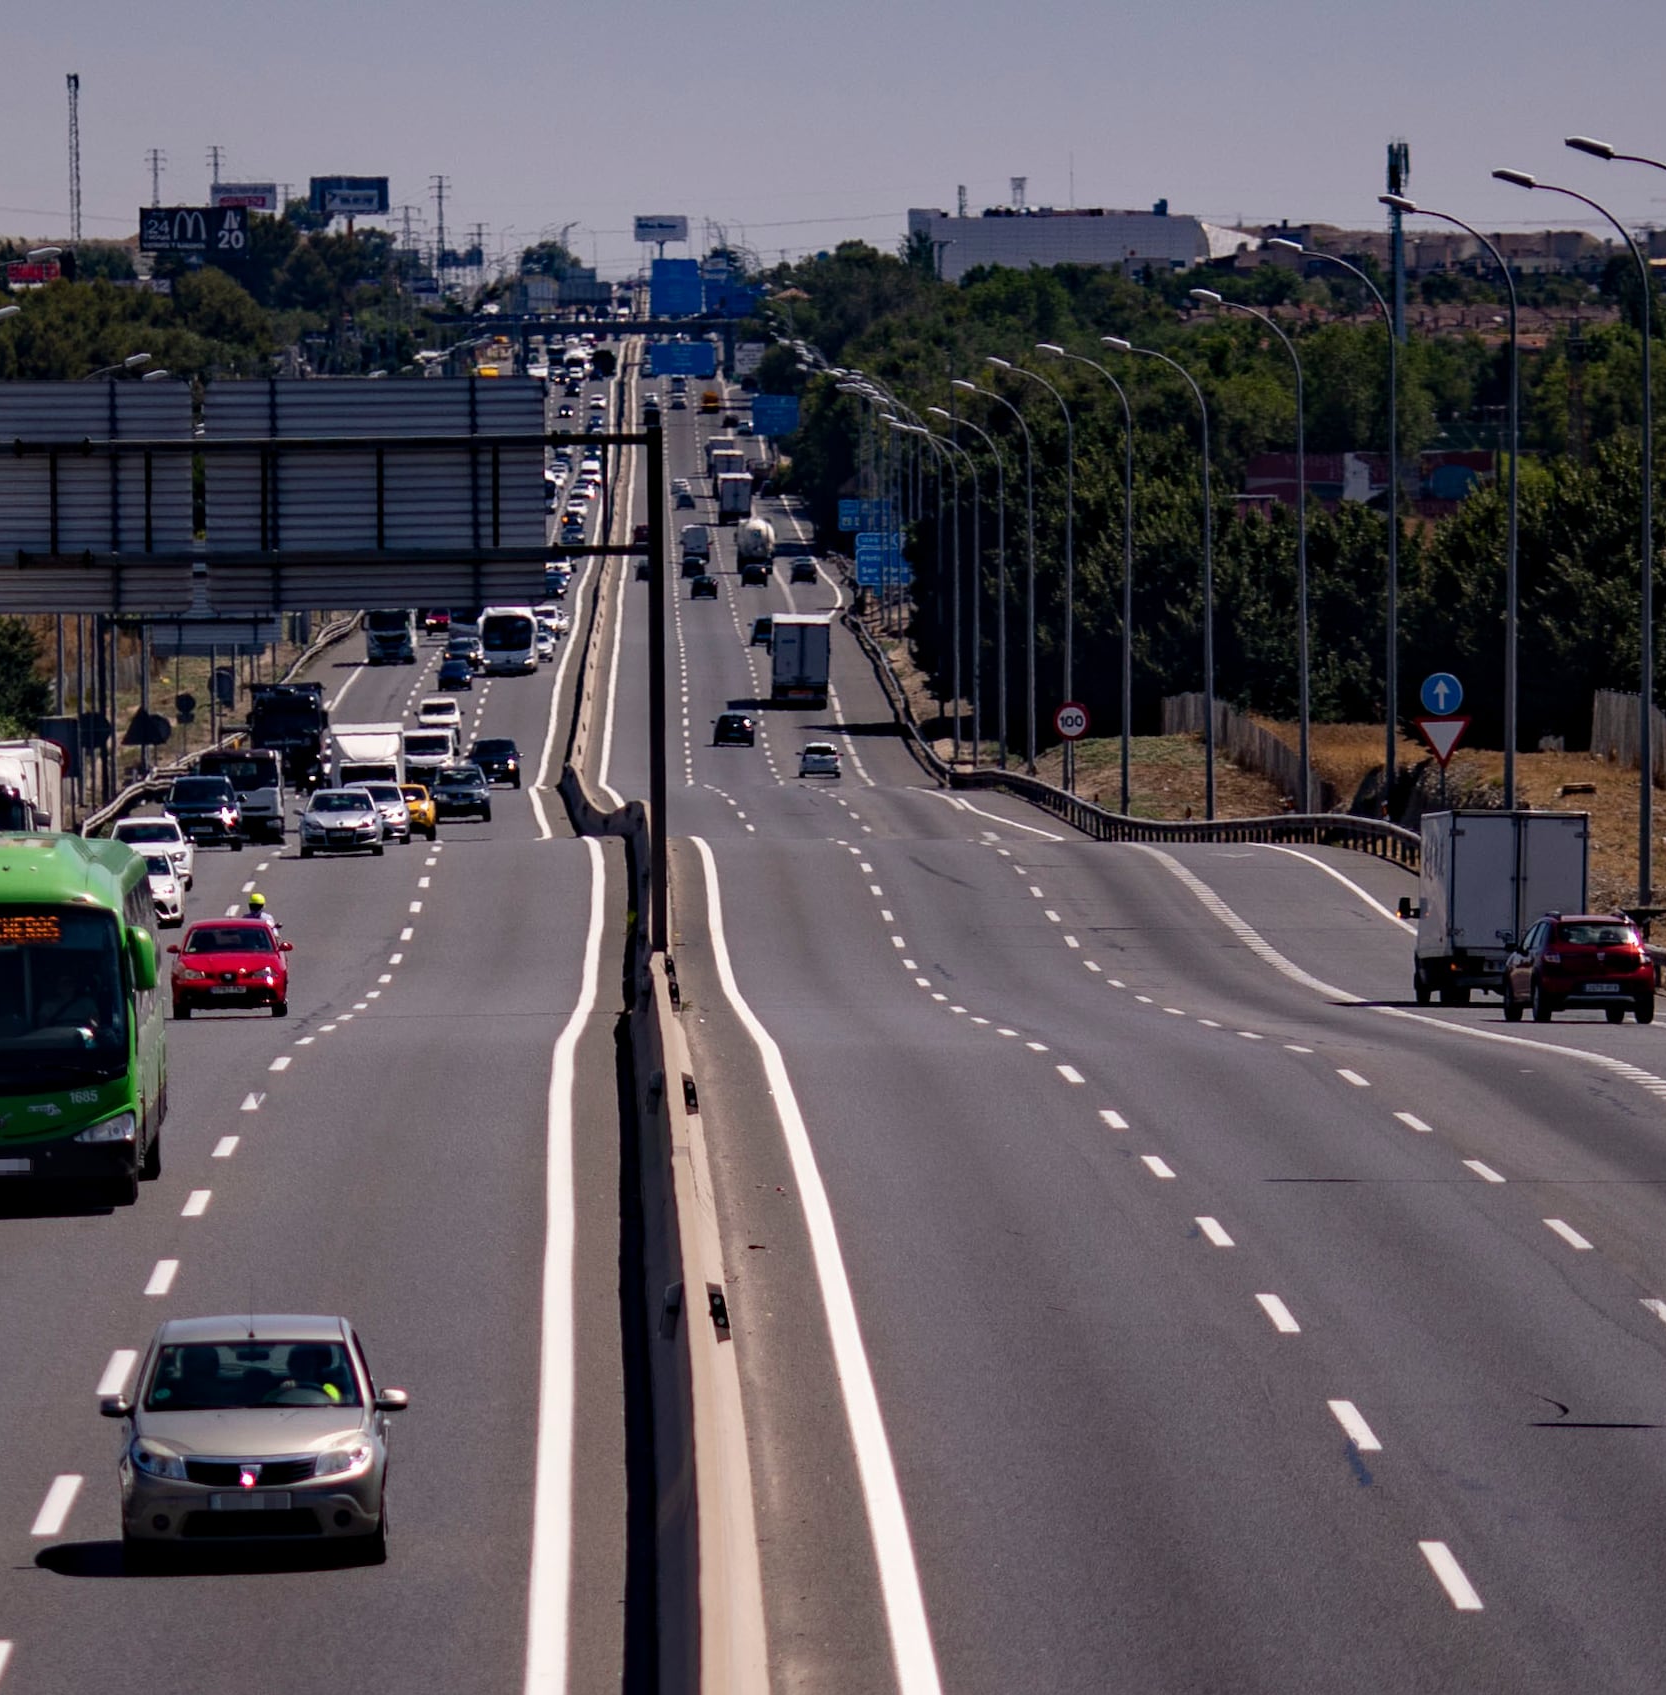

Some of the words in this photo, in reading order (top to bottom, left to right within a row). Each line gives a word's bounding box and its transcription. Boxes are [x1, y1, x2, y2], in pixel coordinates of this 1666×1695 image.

[147, 219, 170, 235] 24
[217, 230, 245, 249] 20
[1059, 715, 1083, 728] 100
[69, 1090, 99, 1104] 1685
